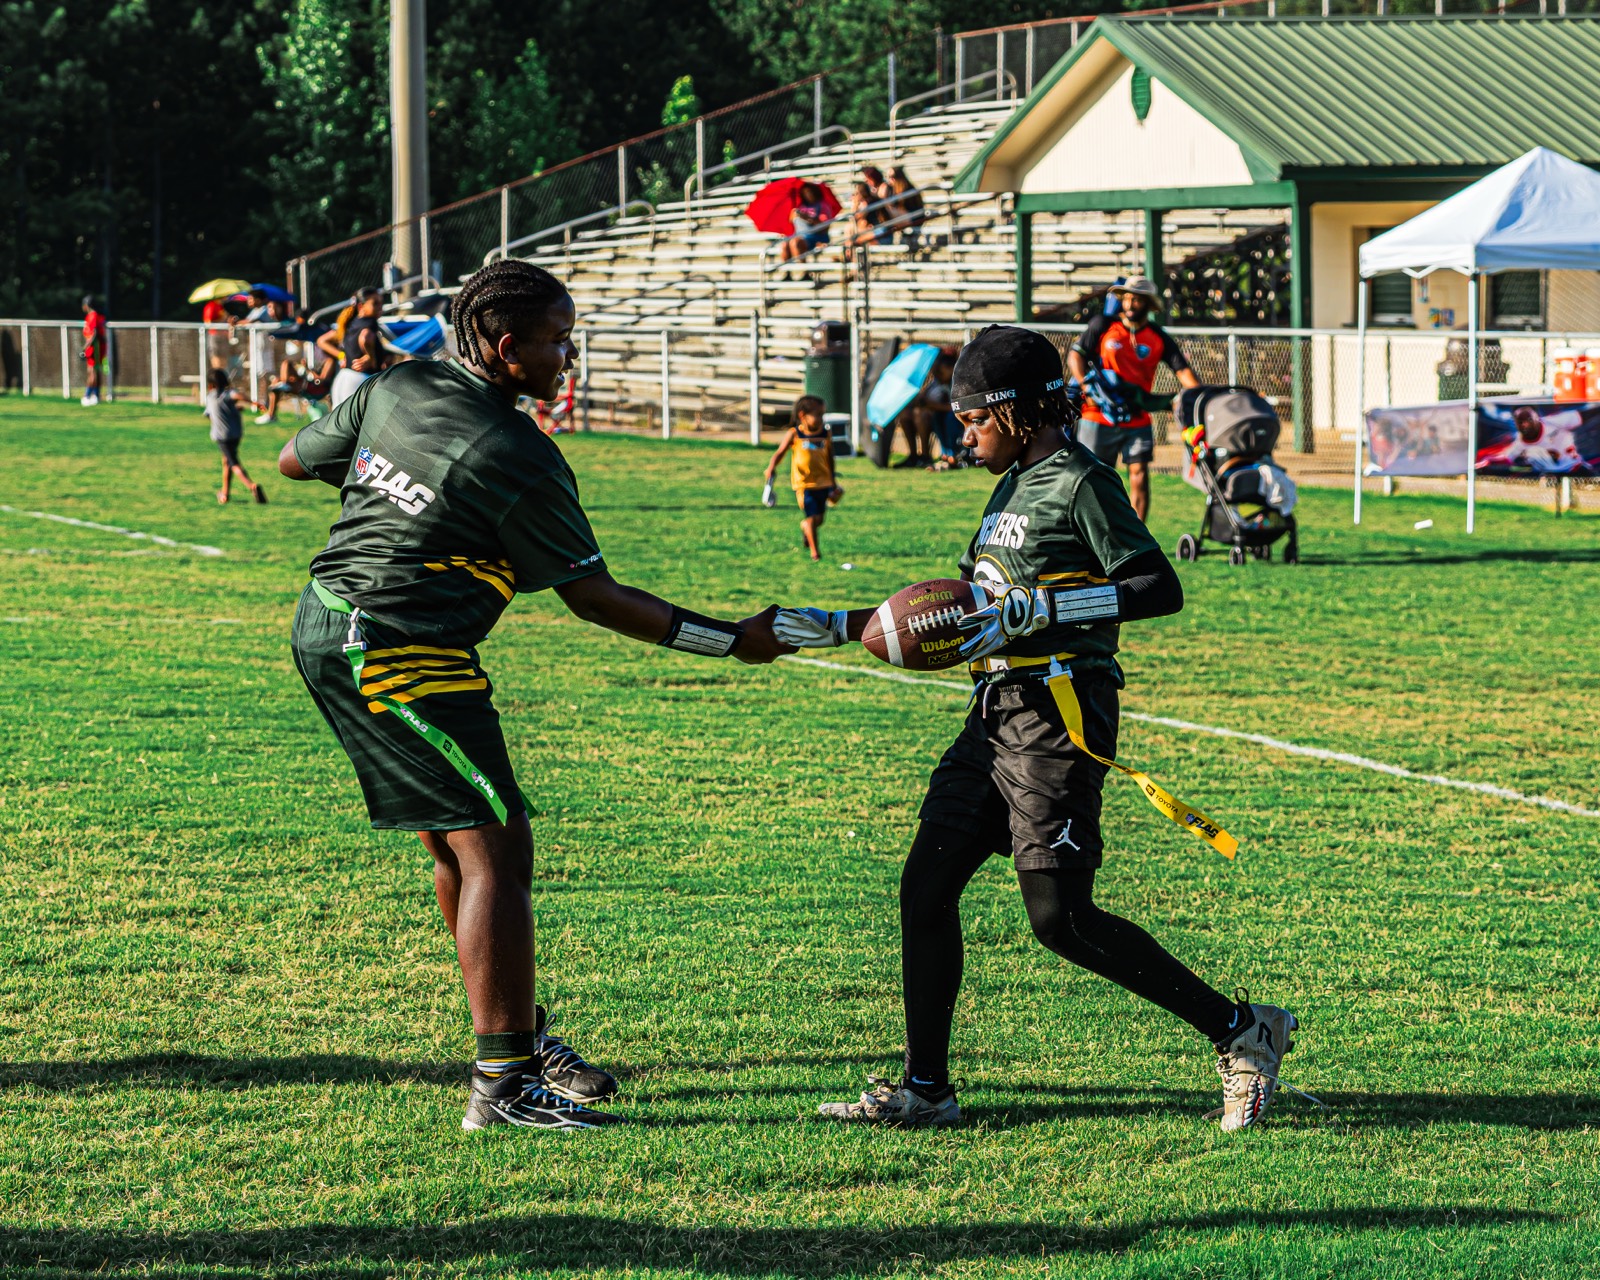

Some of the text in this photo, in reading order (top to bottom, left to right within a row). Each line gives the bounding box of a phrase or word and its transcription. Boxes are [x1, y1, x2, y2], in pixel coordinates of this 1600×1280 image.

[985, 389, 1017, 404] KING
[357, 453, 436, 516] FLAG
[908, 590, 955, 607] Wilson
[920, 635, 965, 653] Wilson
[451, 749, 467, 769] TOYOTA
[1155, 794, 1219, 838] TOYOTA FLAG
